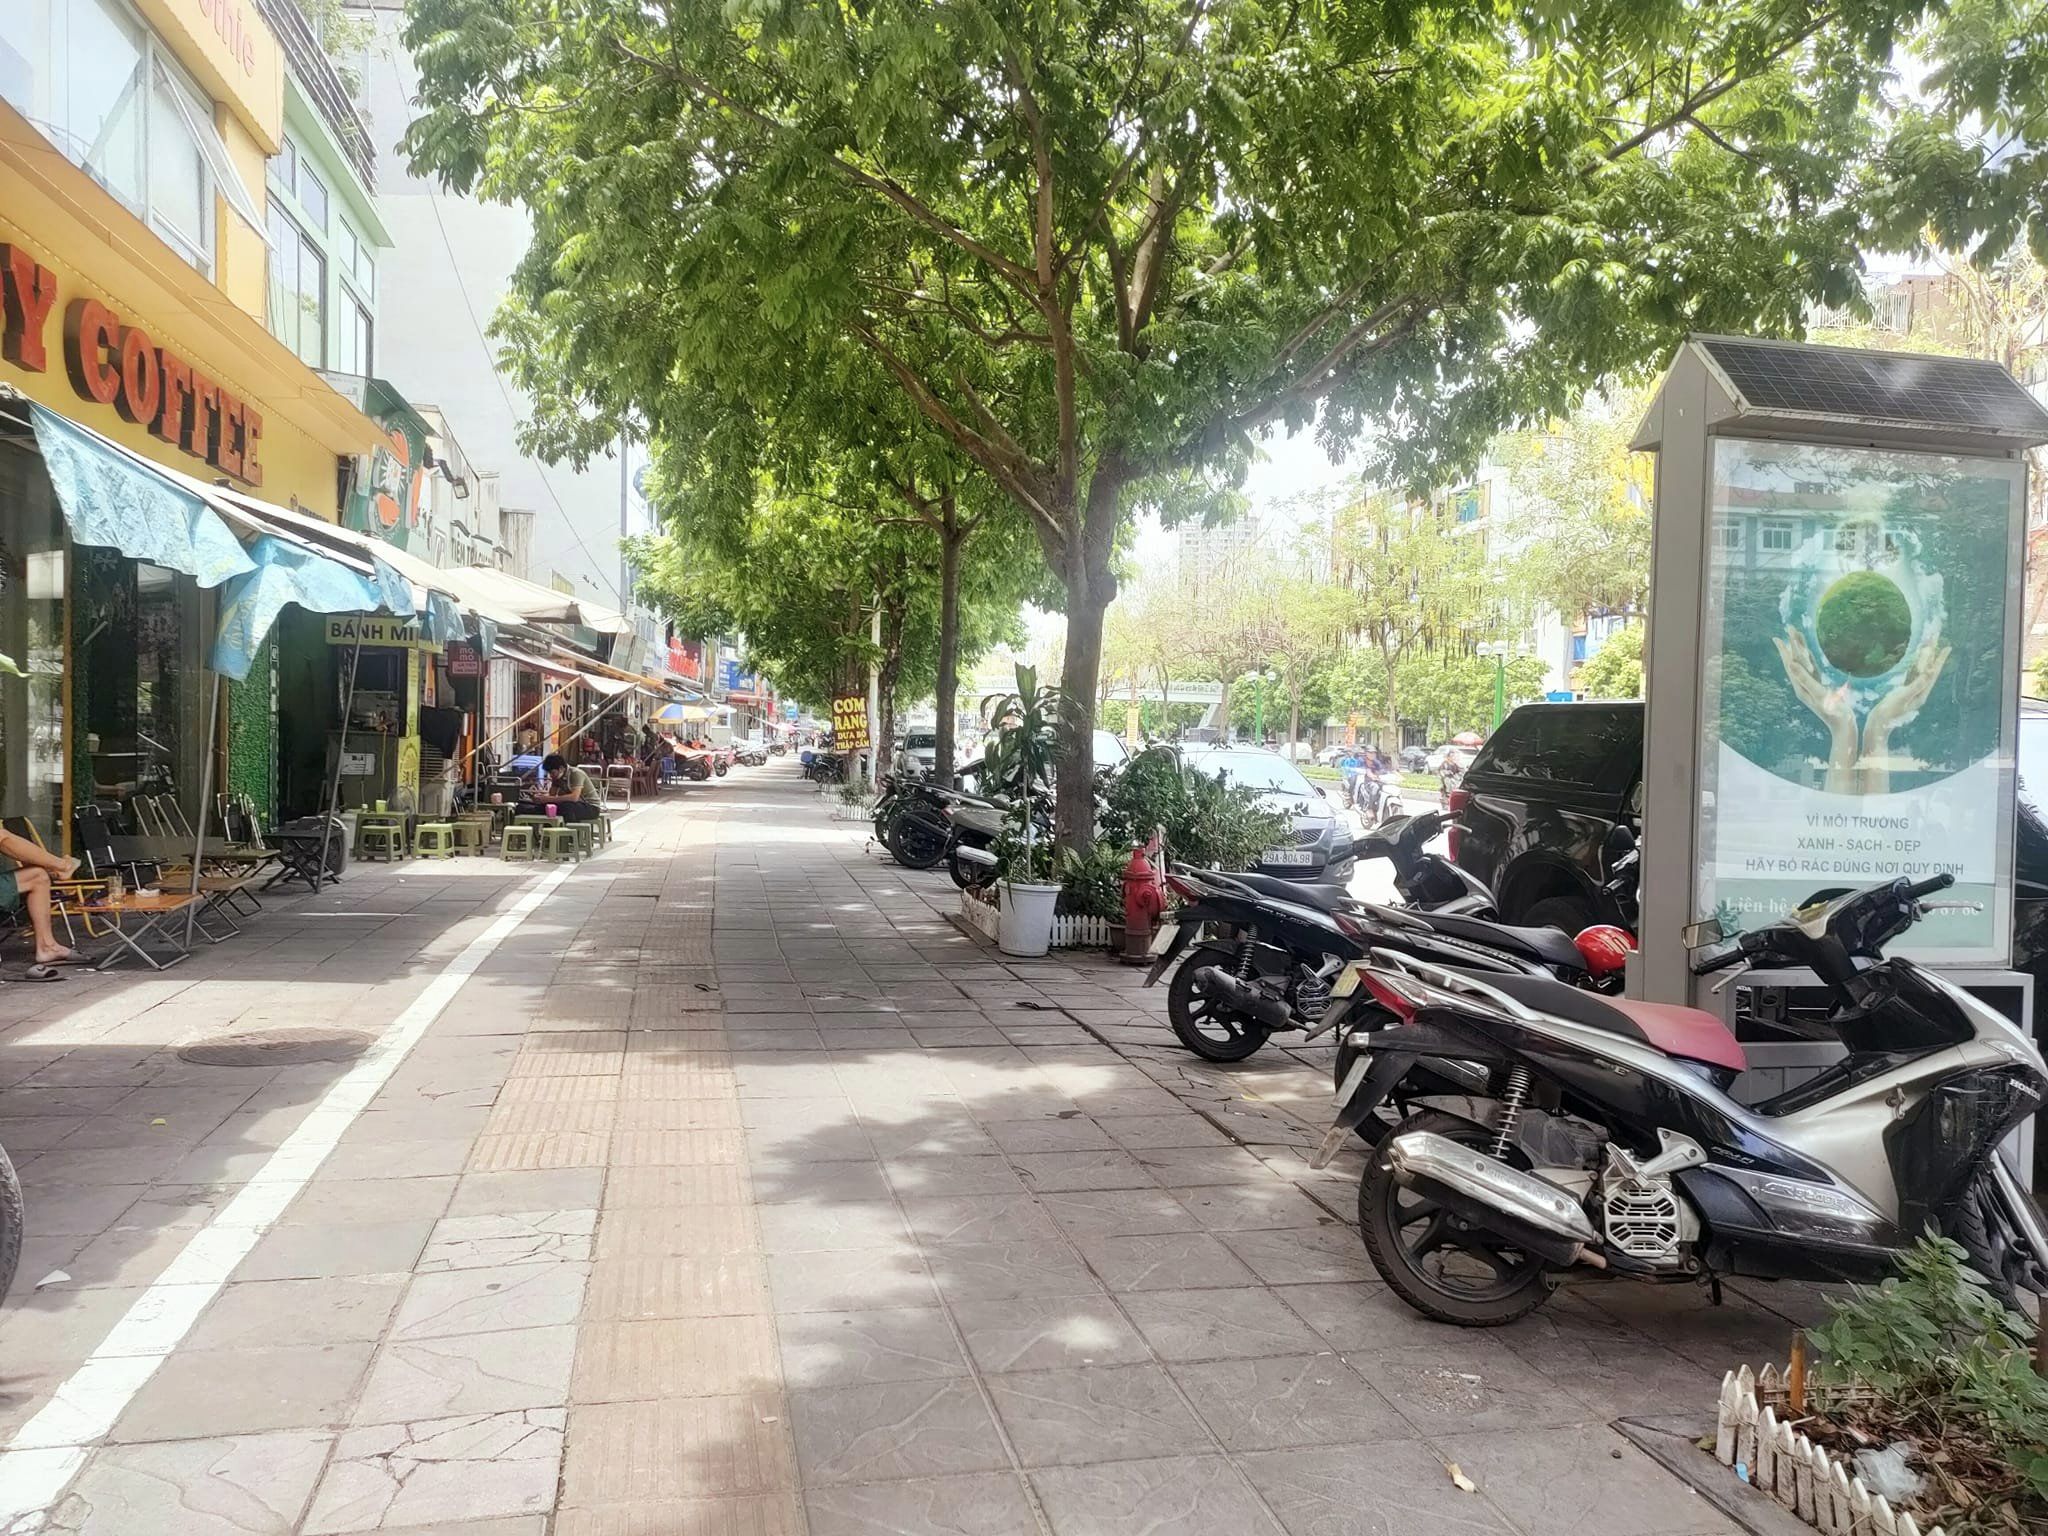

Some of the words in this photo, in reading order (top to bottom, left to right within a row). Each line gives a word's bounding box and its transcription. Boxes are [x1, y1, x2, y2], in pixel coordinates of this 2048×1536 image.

[0, 242, 57, 373] Y
[63, 298, 263, 487] COFFEE
[331, 620, 383, 640] BÁNH
[833, 697, 865, 713] CƠM
[834, 714, 868, 730] RANG
[1797, 837, 1835, 850] XANH
[1846, 839, 1883, 853] SẠCH
[1895, 840, 1921, 855] ĐẸP
[1745, 858, 1775, 872] HÃY
[1801, 858, 1830, 873] RÁC
[1833, 859, 1871, 874] ĐÚNG
[1875, 862, 1900, 874] NƠI
[1902, 862, 1930, 876] QUY
[2009, 1078, 2041, 1101] HONDA
